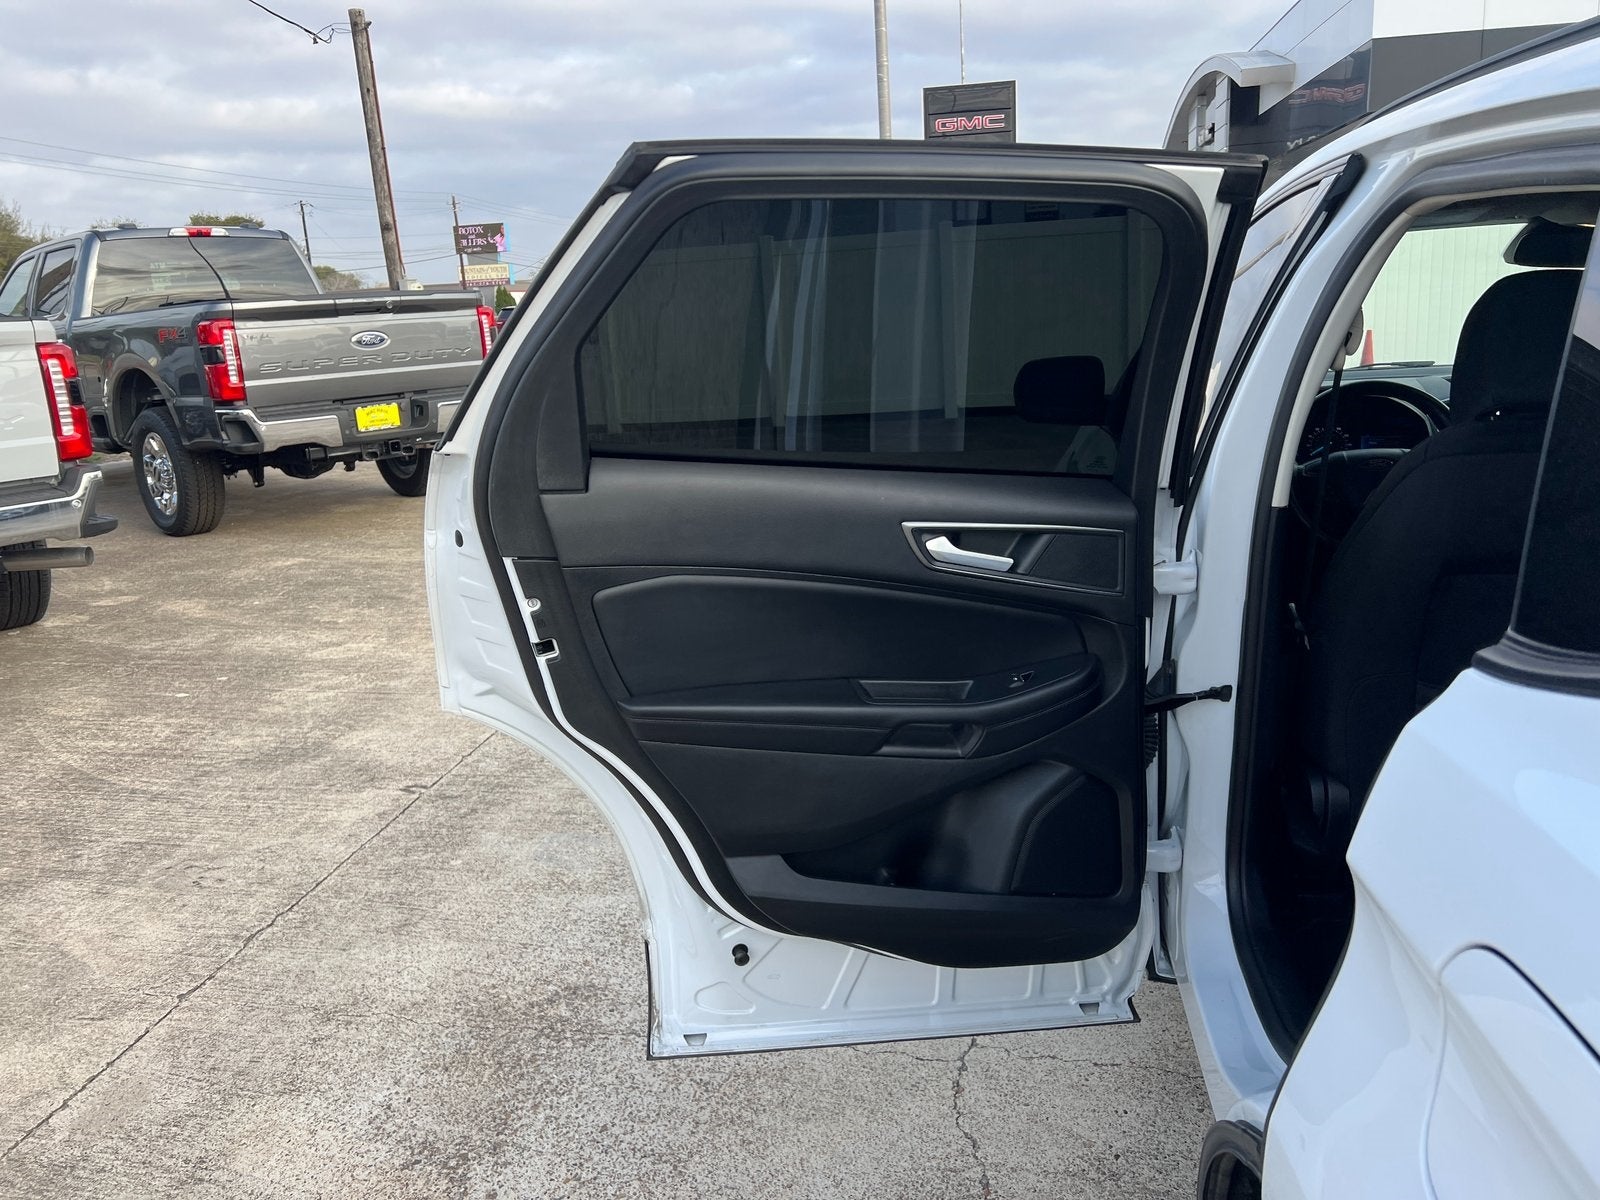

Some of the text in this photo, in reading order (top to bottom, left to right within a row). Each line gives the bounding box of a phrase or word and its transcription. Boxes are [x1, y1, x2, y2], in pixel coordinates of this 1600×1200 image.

[935, 114, 1005, 133] GMC
[458, 226, 484, 235] BOTOX
[158, 327, 187, 344] FX4
[361, 334, 381, 345] Ford
[259, 346, 472, 374] SUPER DUTY
